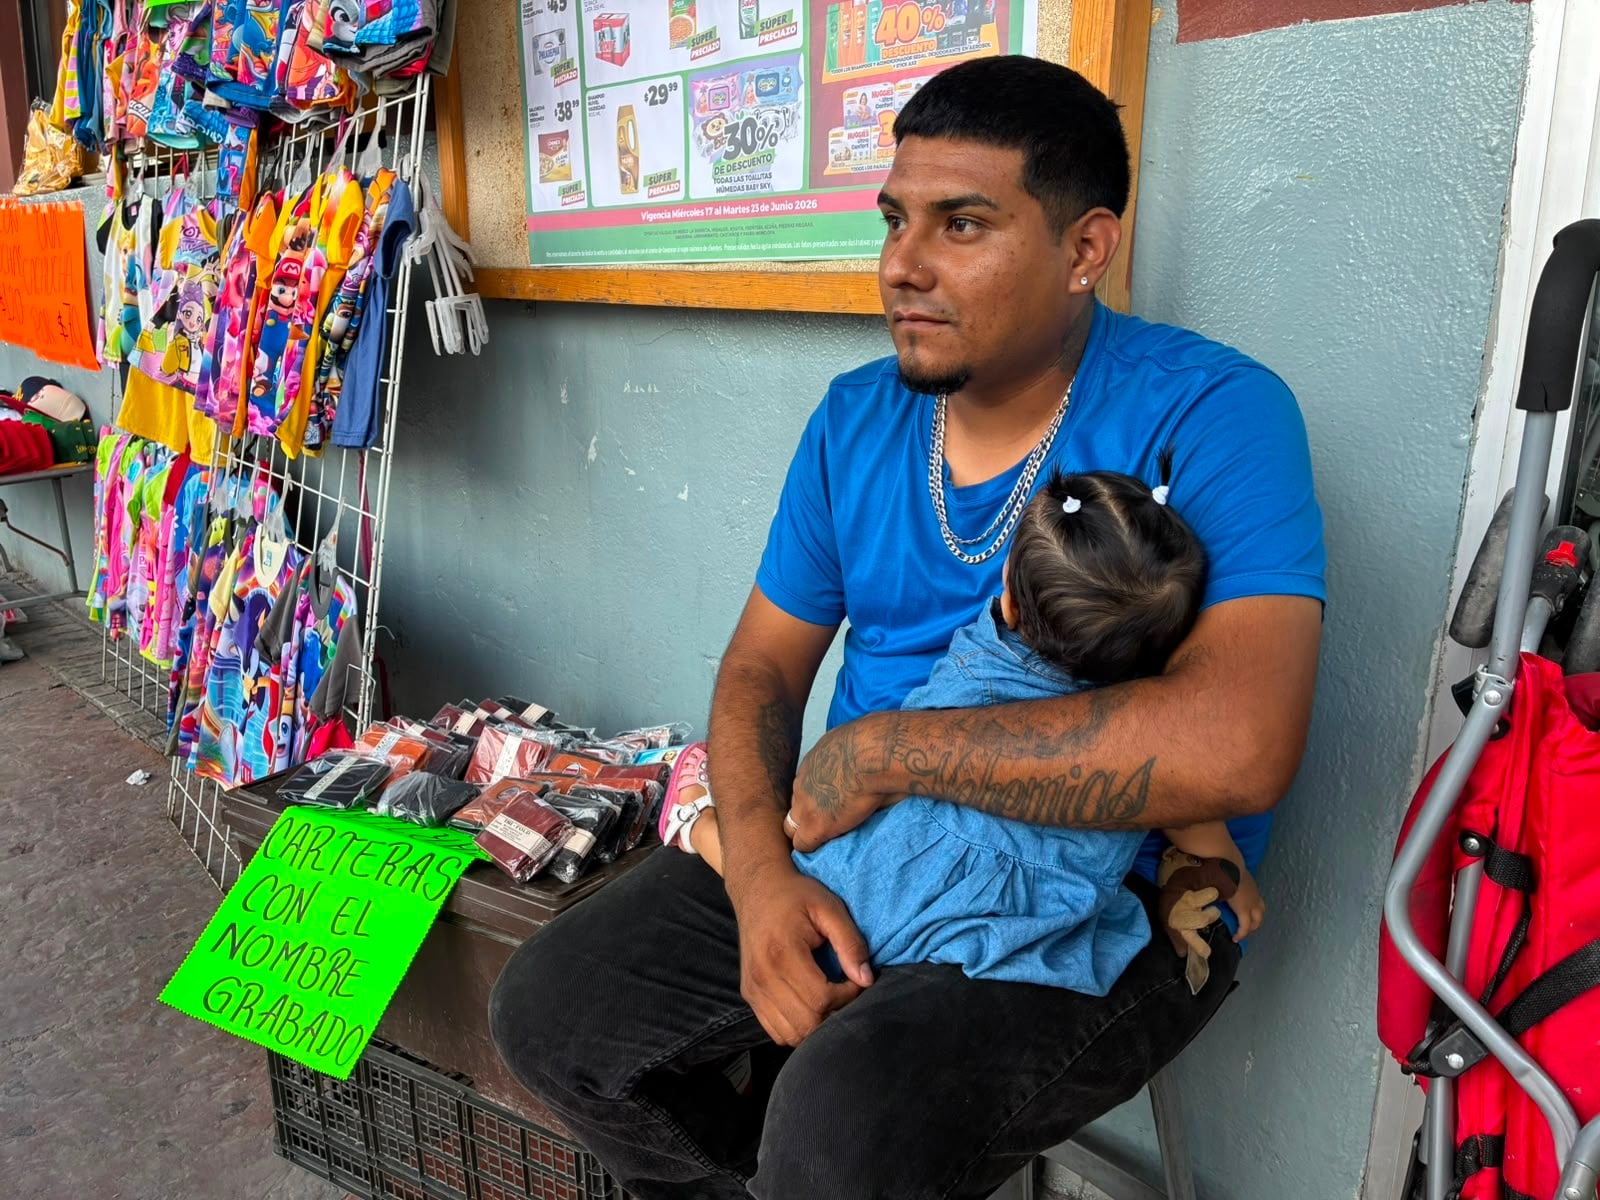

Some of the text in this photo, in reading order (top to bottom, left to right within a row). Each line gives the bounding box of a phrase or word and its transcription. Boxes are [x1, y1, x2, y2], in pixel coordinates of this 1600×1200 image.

[760, 14, 787, 31] SÚPER
[875, 1, 945, 46] 40%
[691, 30, 713, 48] SÚPER
[759, 24, 797, 45] PRECIAZO
[691, 40, 720, 59] PRECIAZO
[882, 40, 936, 58] DESCUENTO
[872, 88, 893, 99] HUGGIES
[723, 117, 778, 160] 30%
[848, 131, 869, 140] HUGGIES
[714, 153, 773, 175] DE DESCUENTO
[649, 171, 673, 185] SÚPER
[713, 172, 773, 185] TODAS LAS TOALLITAS
[562, 183, 579, 195] SÚPER
[648, 182, 680, 196] PRECIAZO
[715, 183, 745, 194] HÚMEDAS
[760, 182, 771, 190] SKY
[562, 192, 585, 205] PRECIAZO
[640, 209, 671, 222] Vigencia
[672, 206, 704, 218] Miércoles
[705, 207, 713, 216] 17
[714, 206, 722, 215] al
[723, 204, 750, 215] Martes
[760, 202, 770, 212] de
[771, 200, 794, 211] Junio
[795, 198, 818, 210] 2026
[263, 817, 462, 901] CARTERAS
[242, 874, 371, 937] CON EL
[210, 922, 370, 998] NOMBRE
[202, 976, 364, 1067] GRABADO
